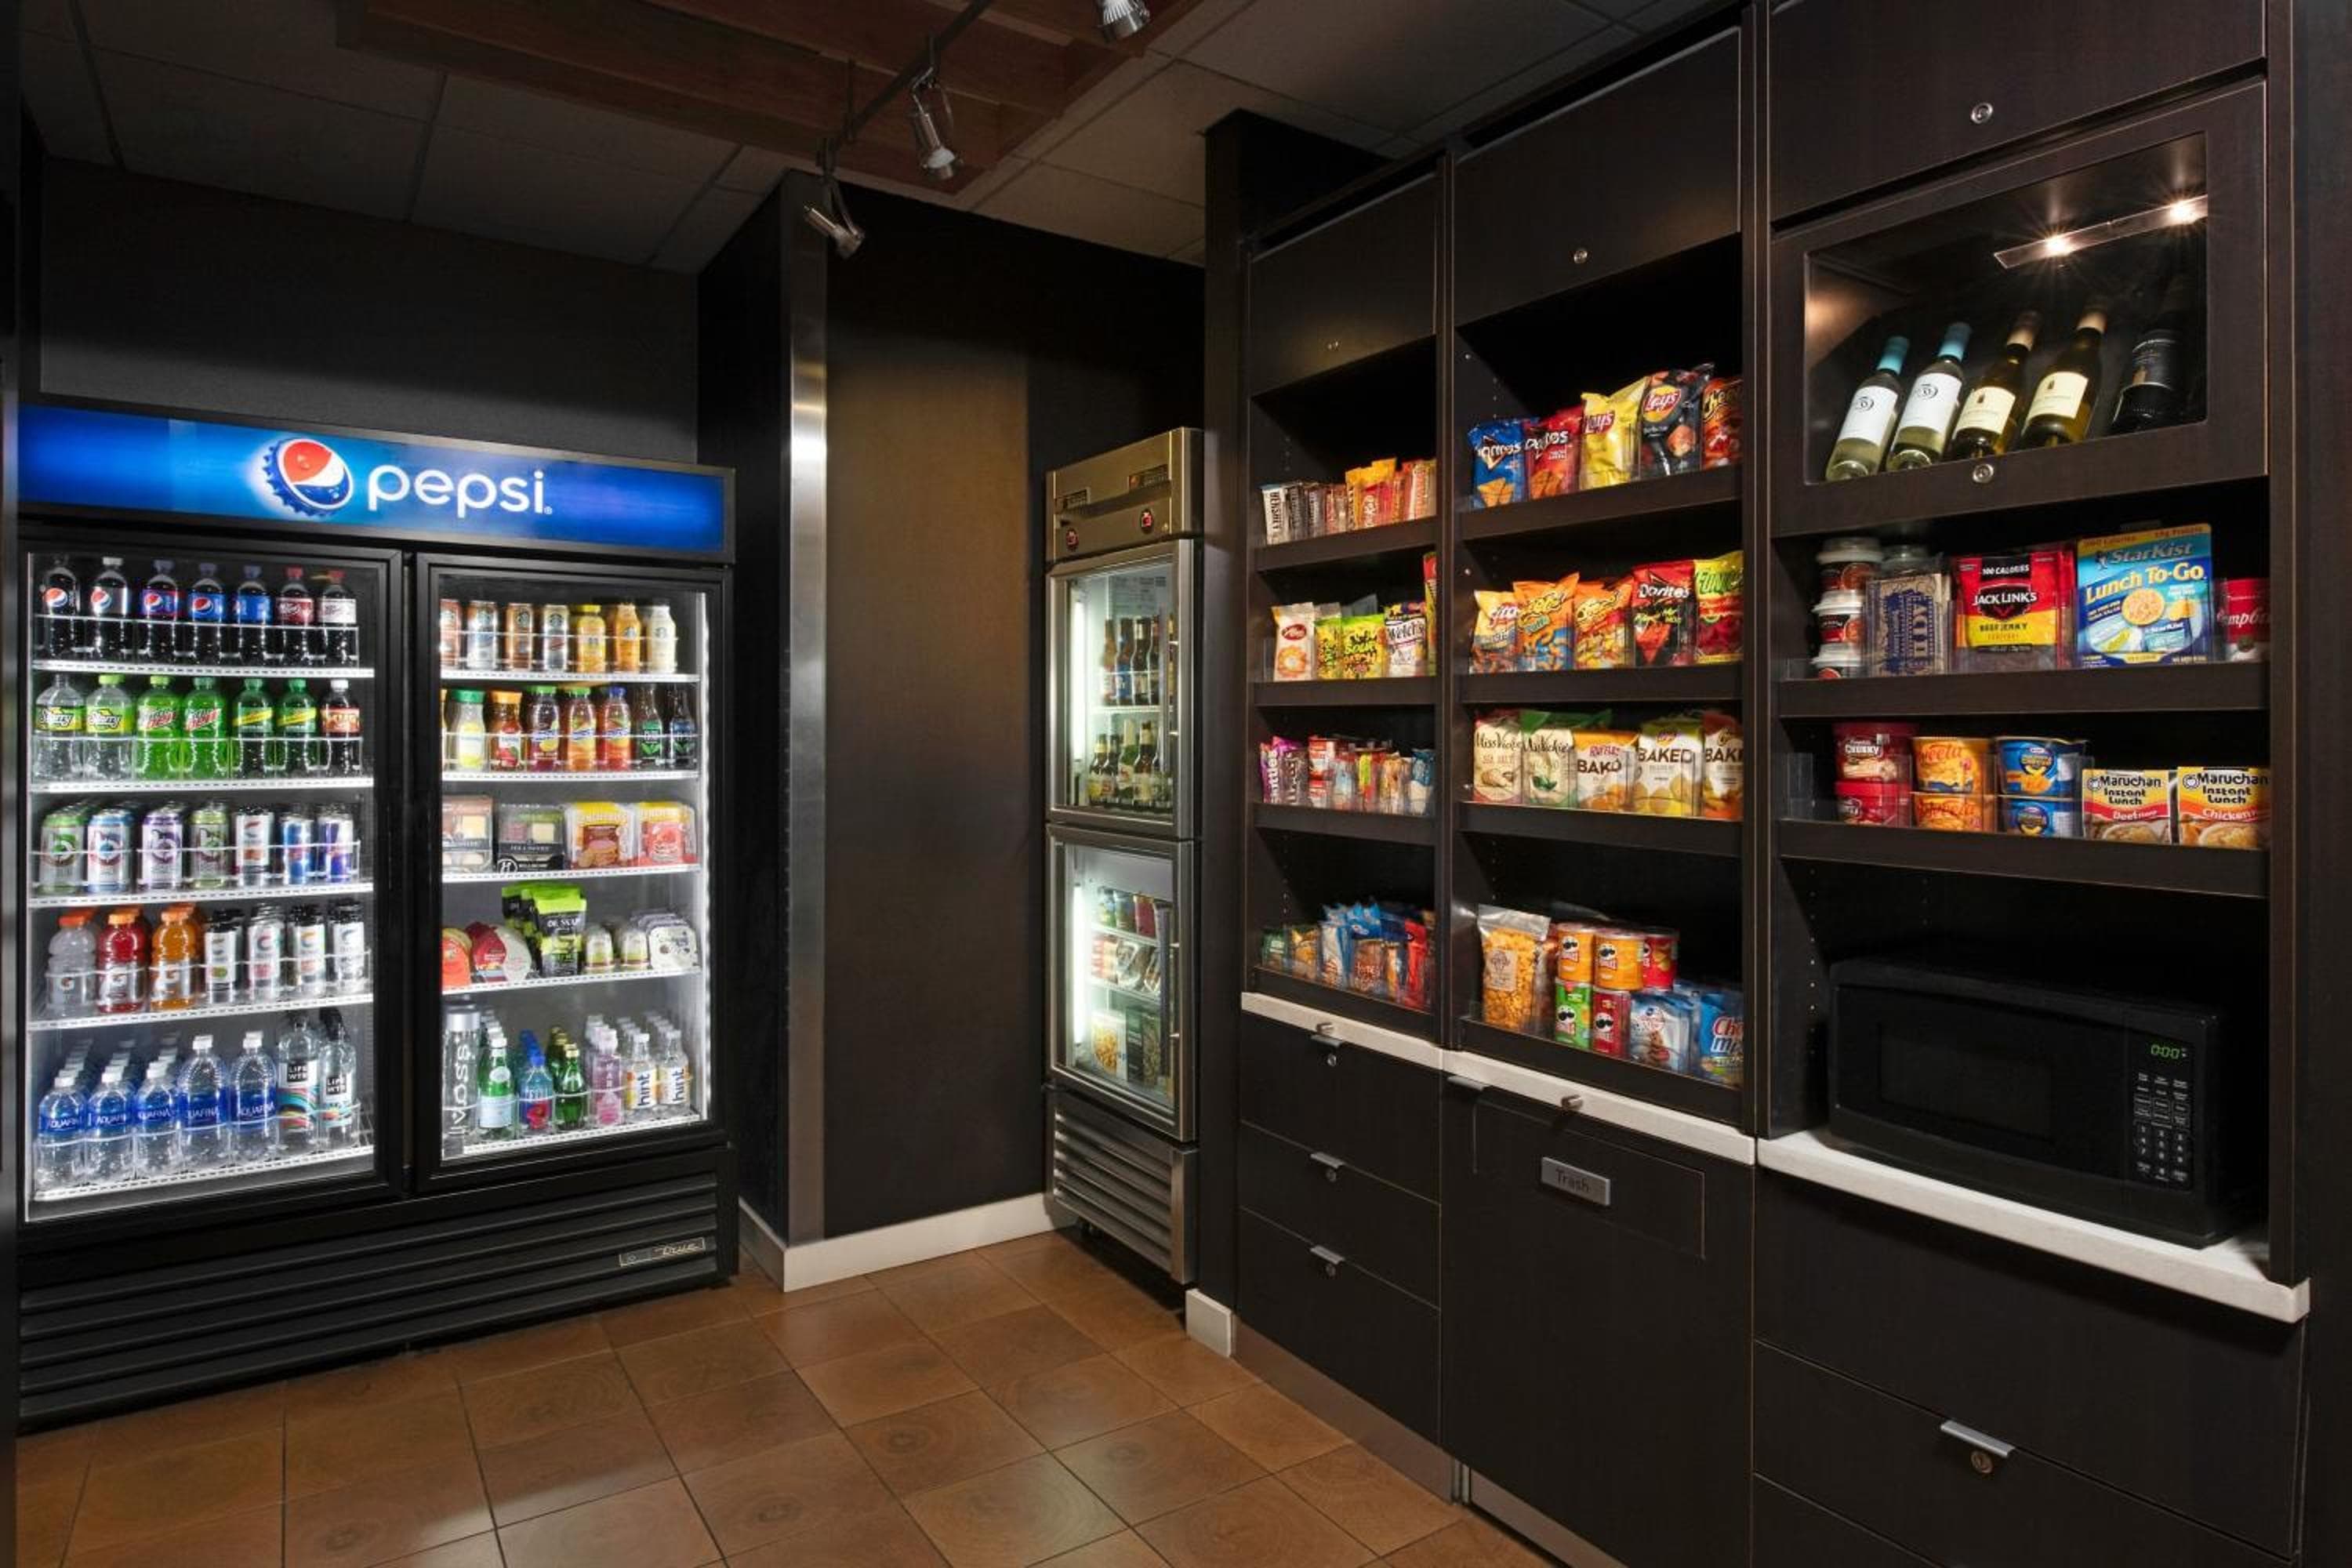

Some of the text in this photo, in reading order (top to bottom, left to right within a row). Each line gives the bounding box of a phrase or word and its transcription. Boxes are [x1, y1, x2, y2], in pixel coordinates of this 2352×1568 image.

[368, 464, 544, 518] pepsi
[2111, 542, 2193, 564] StarKist
[1639, 583, 1690, 598] Doritos
[2085, 570, 2143, 604] Lunch
[1973, 593, 2001, 606] JACK
[1637, 748, 1693, 764] BAKED
[2100, 775, 2161, 787] Maruchan
[2198, 772, 2268, 785] Maruchan
[2104, 789, 2146, 797] Instant
[2202, 786, 2252, 795] Instant
[2109, 797, 2143, 805] Lunch
[2208, 795, 2246, 804] Lunch
[2202, 809, 2252, 821] Chicken
